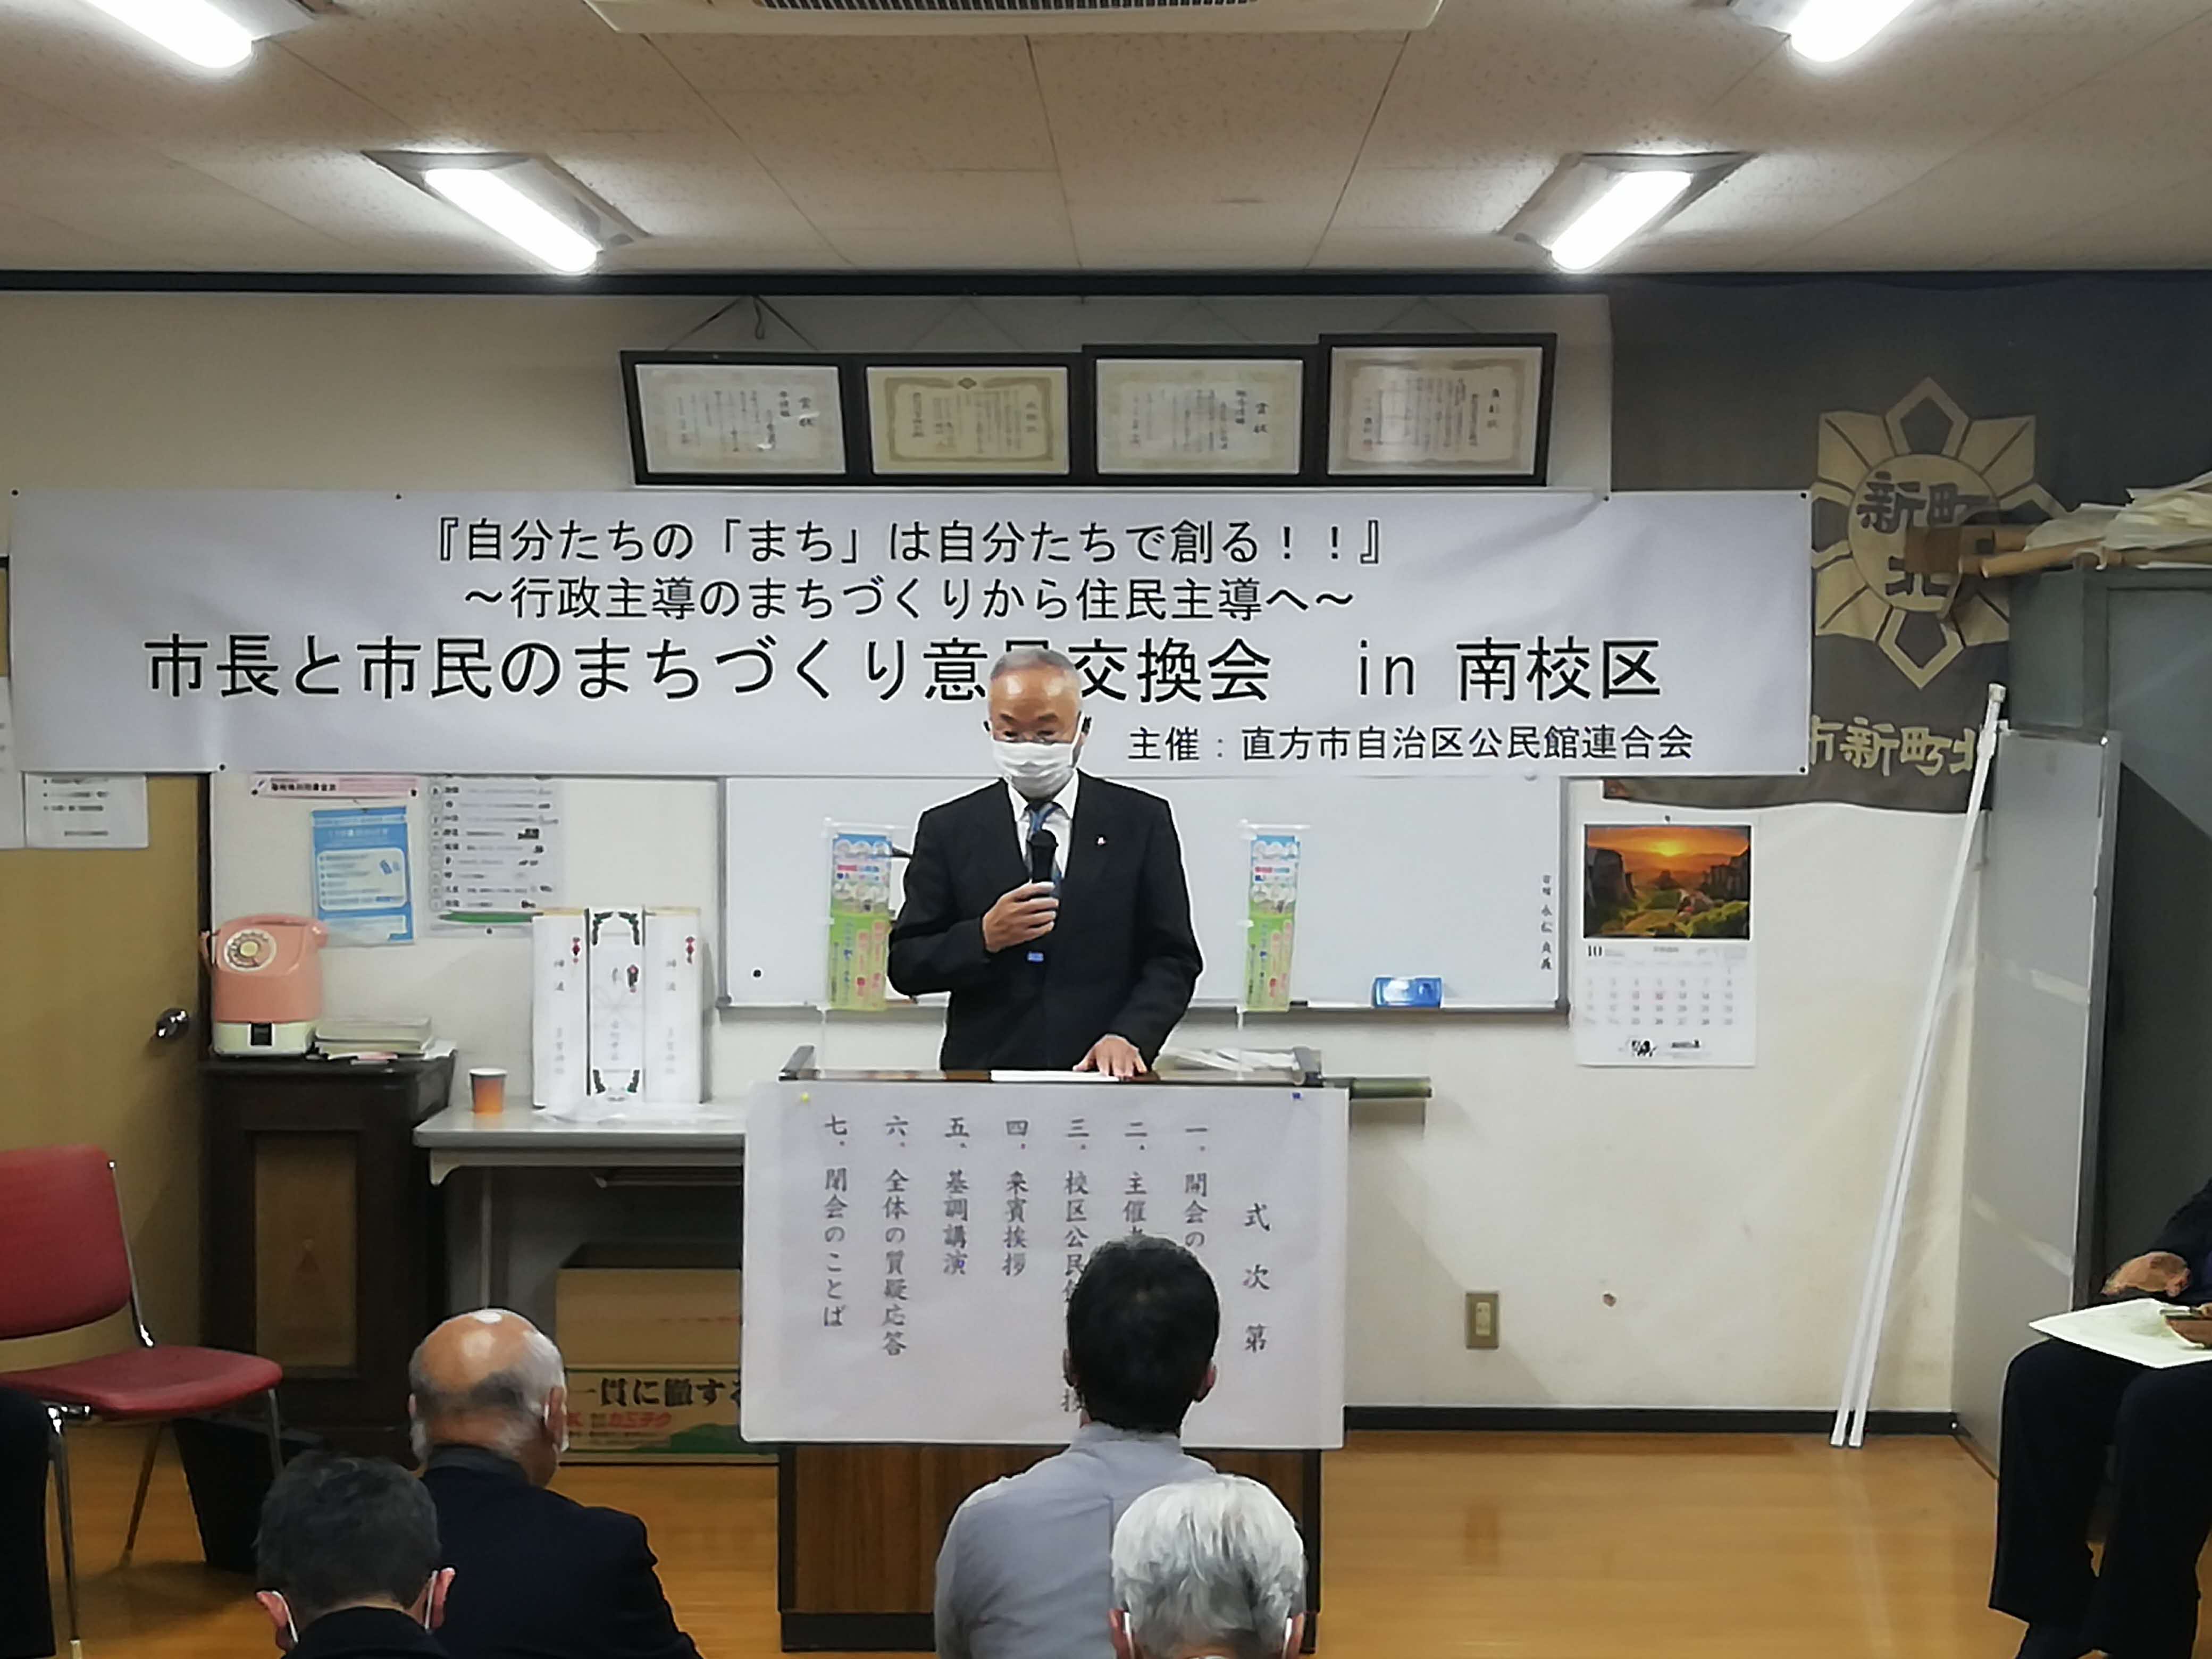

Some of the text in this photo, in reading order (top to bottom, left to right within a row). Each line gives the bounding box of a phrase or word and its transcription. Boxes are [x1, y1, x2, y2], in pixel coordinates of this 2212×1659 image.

[144, 633, 1661, 702] 市長と市民のまちづくり意交換会 in 南校区
[1243, 1202, 1271, 1353] 式次第
